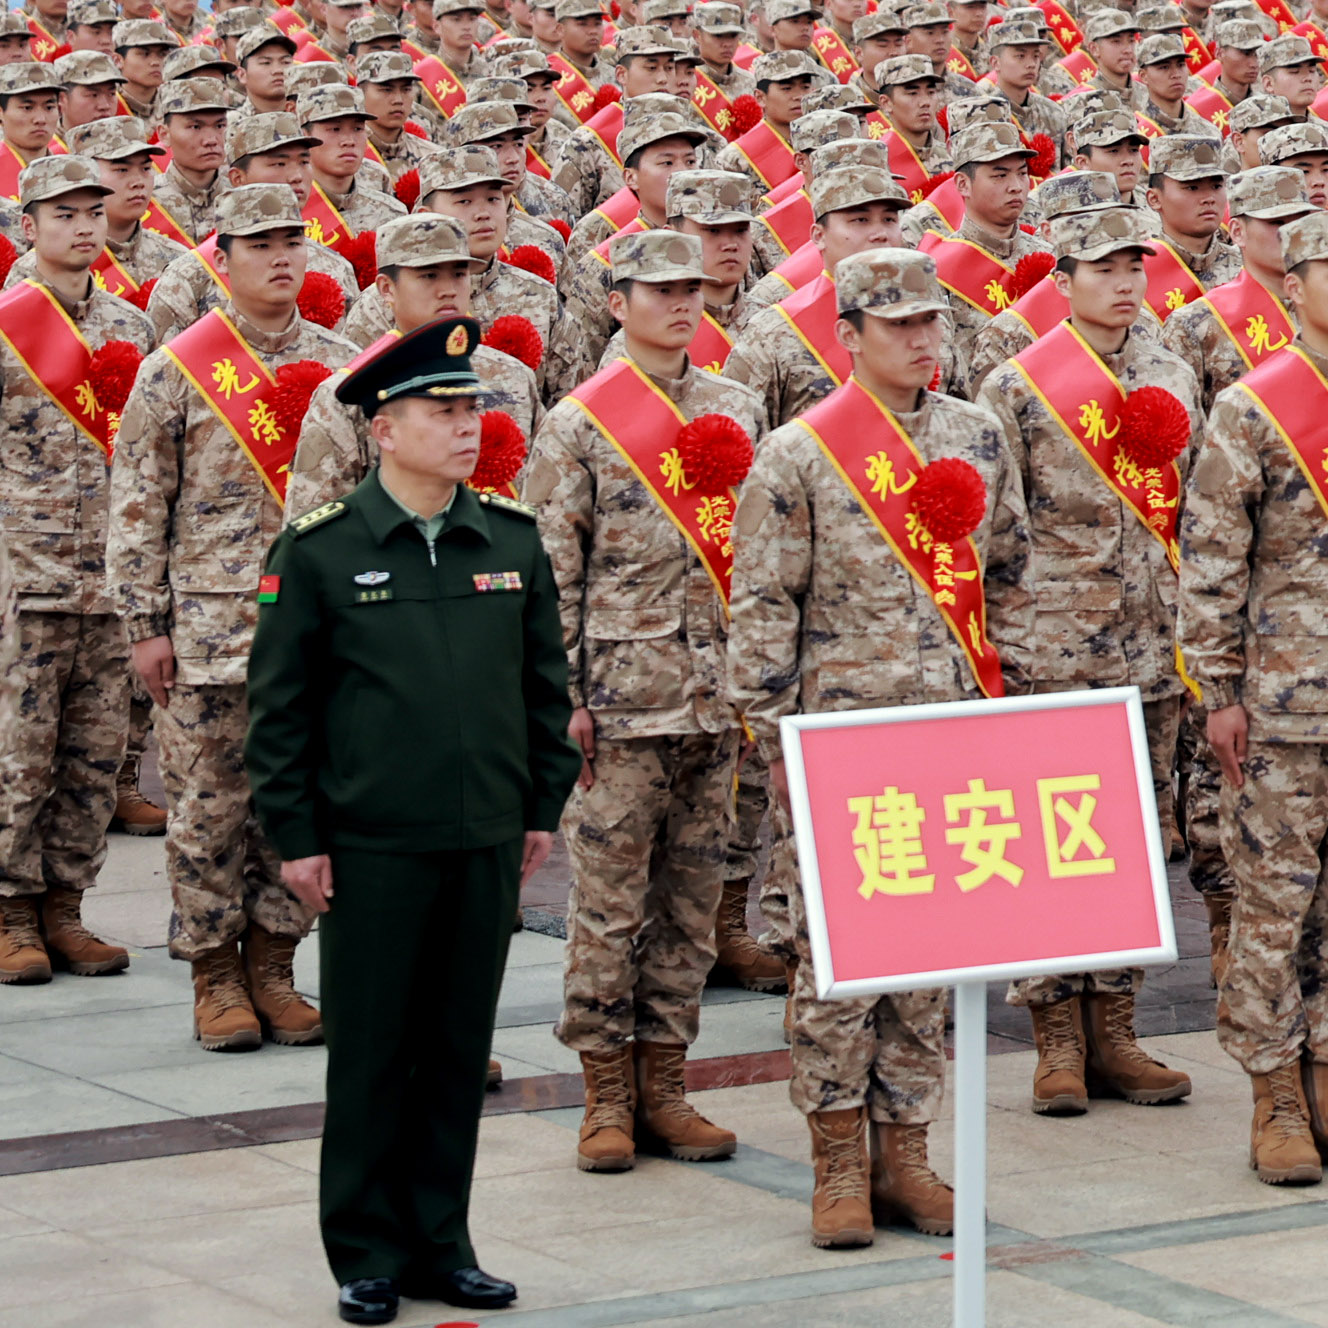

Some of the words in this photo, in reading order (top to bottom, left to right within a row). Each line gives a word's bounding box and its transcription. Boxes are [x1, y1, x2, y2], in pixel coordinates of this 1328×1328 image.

[1245, 314, 1289, 356] 光
[847, 773, 1116, 900] 建安区
